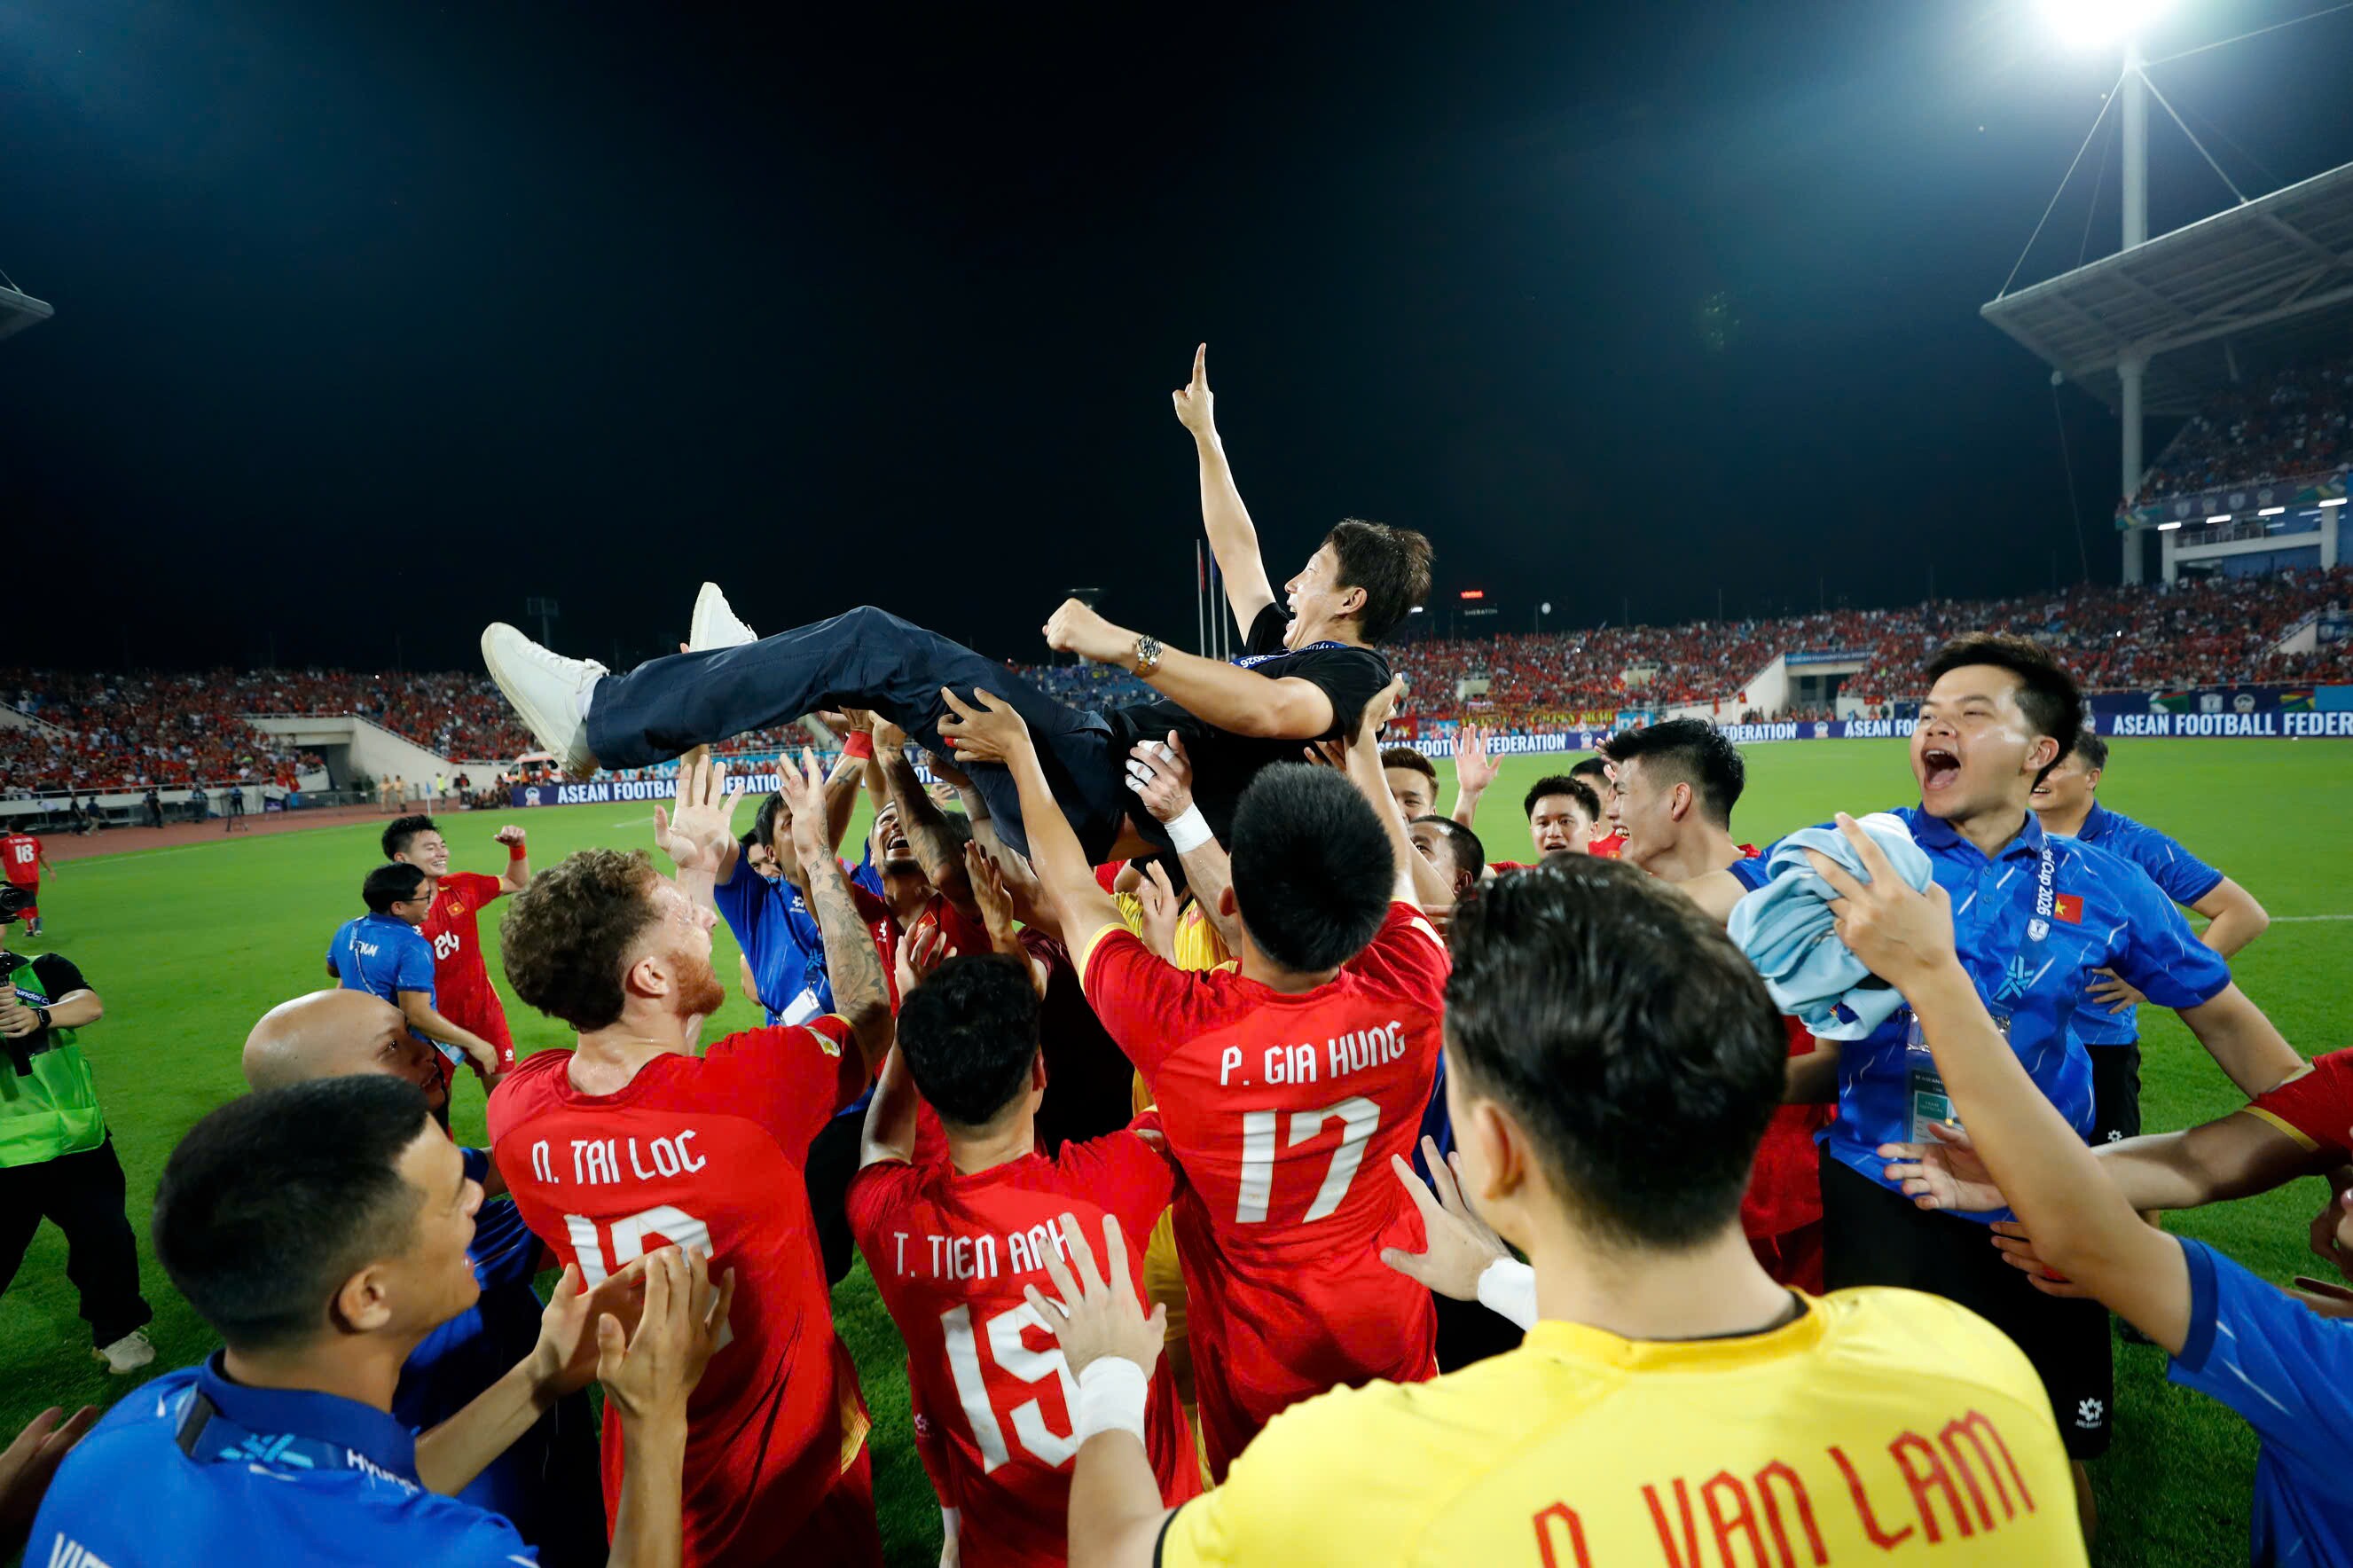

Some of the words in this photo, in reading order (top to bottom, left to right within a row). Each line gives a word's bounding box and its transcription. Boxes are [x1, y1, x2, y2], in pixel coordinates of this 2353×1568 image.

[1240, 655, 1268, 668] 2026
[1844, 719, 1892, 738] ASEAN
[2113, 713, 2169, 735] ASEAN
[2175, 712, 2277, 735] FOOTBALL
[2283, 711, 2353, 735] FEDER
[1486, 733, 1566, 754] FEDERATION
[557, 782, 609, 804] ASEAN
[613, 780, 678, 801] FOOTBA
[15, 843, 35, 865] 18
[2037, 861, 2055, 886] Cup
[2036, 887, 2054, 917] 2026
[434, 930, 460, 960] 24
[1220, 1046, 1250, 1086] P.
[1265, 1043, 1317, 1086] GIA
[1328, 1020, 1406, 1079] HUNG
[532, 1140, 560, 1184] N.
[570, 1139, 621, 1185] TAI
[628, 1129, 706, 1180] LOC
[1235, 1095, 1381, 1224] 17
[894, 1232, 916, 1277] T.
[928, 1234, 999, 1281] TIEN
[1640, 1459, 1830, 1568] VAN
[1826, 1408, 2037, 1552] LAM
